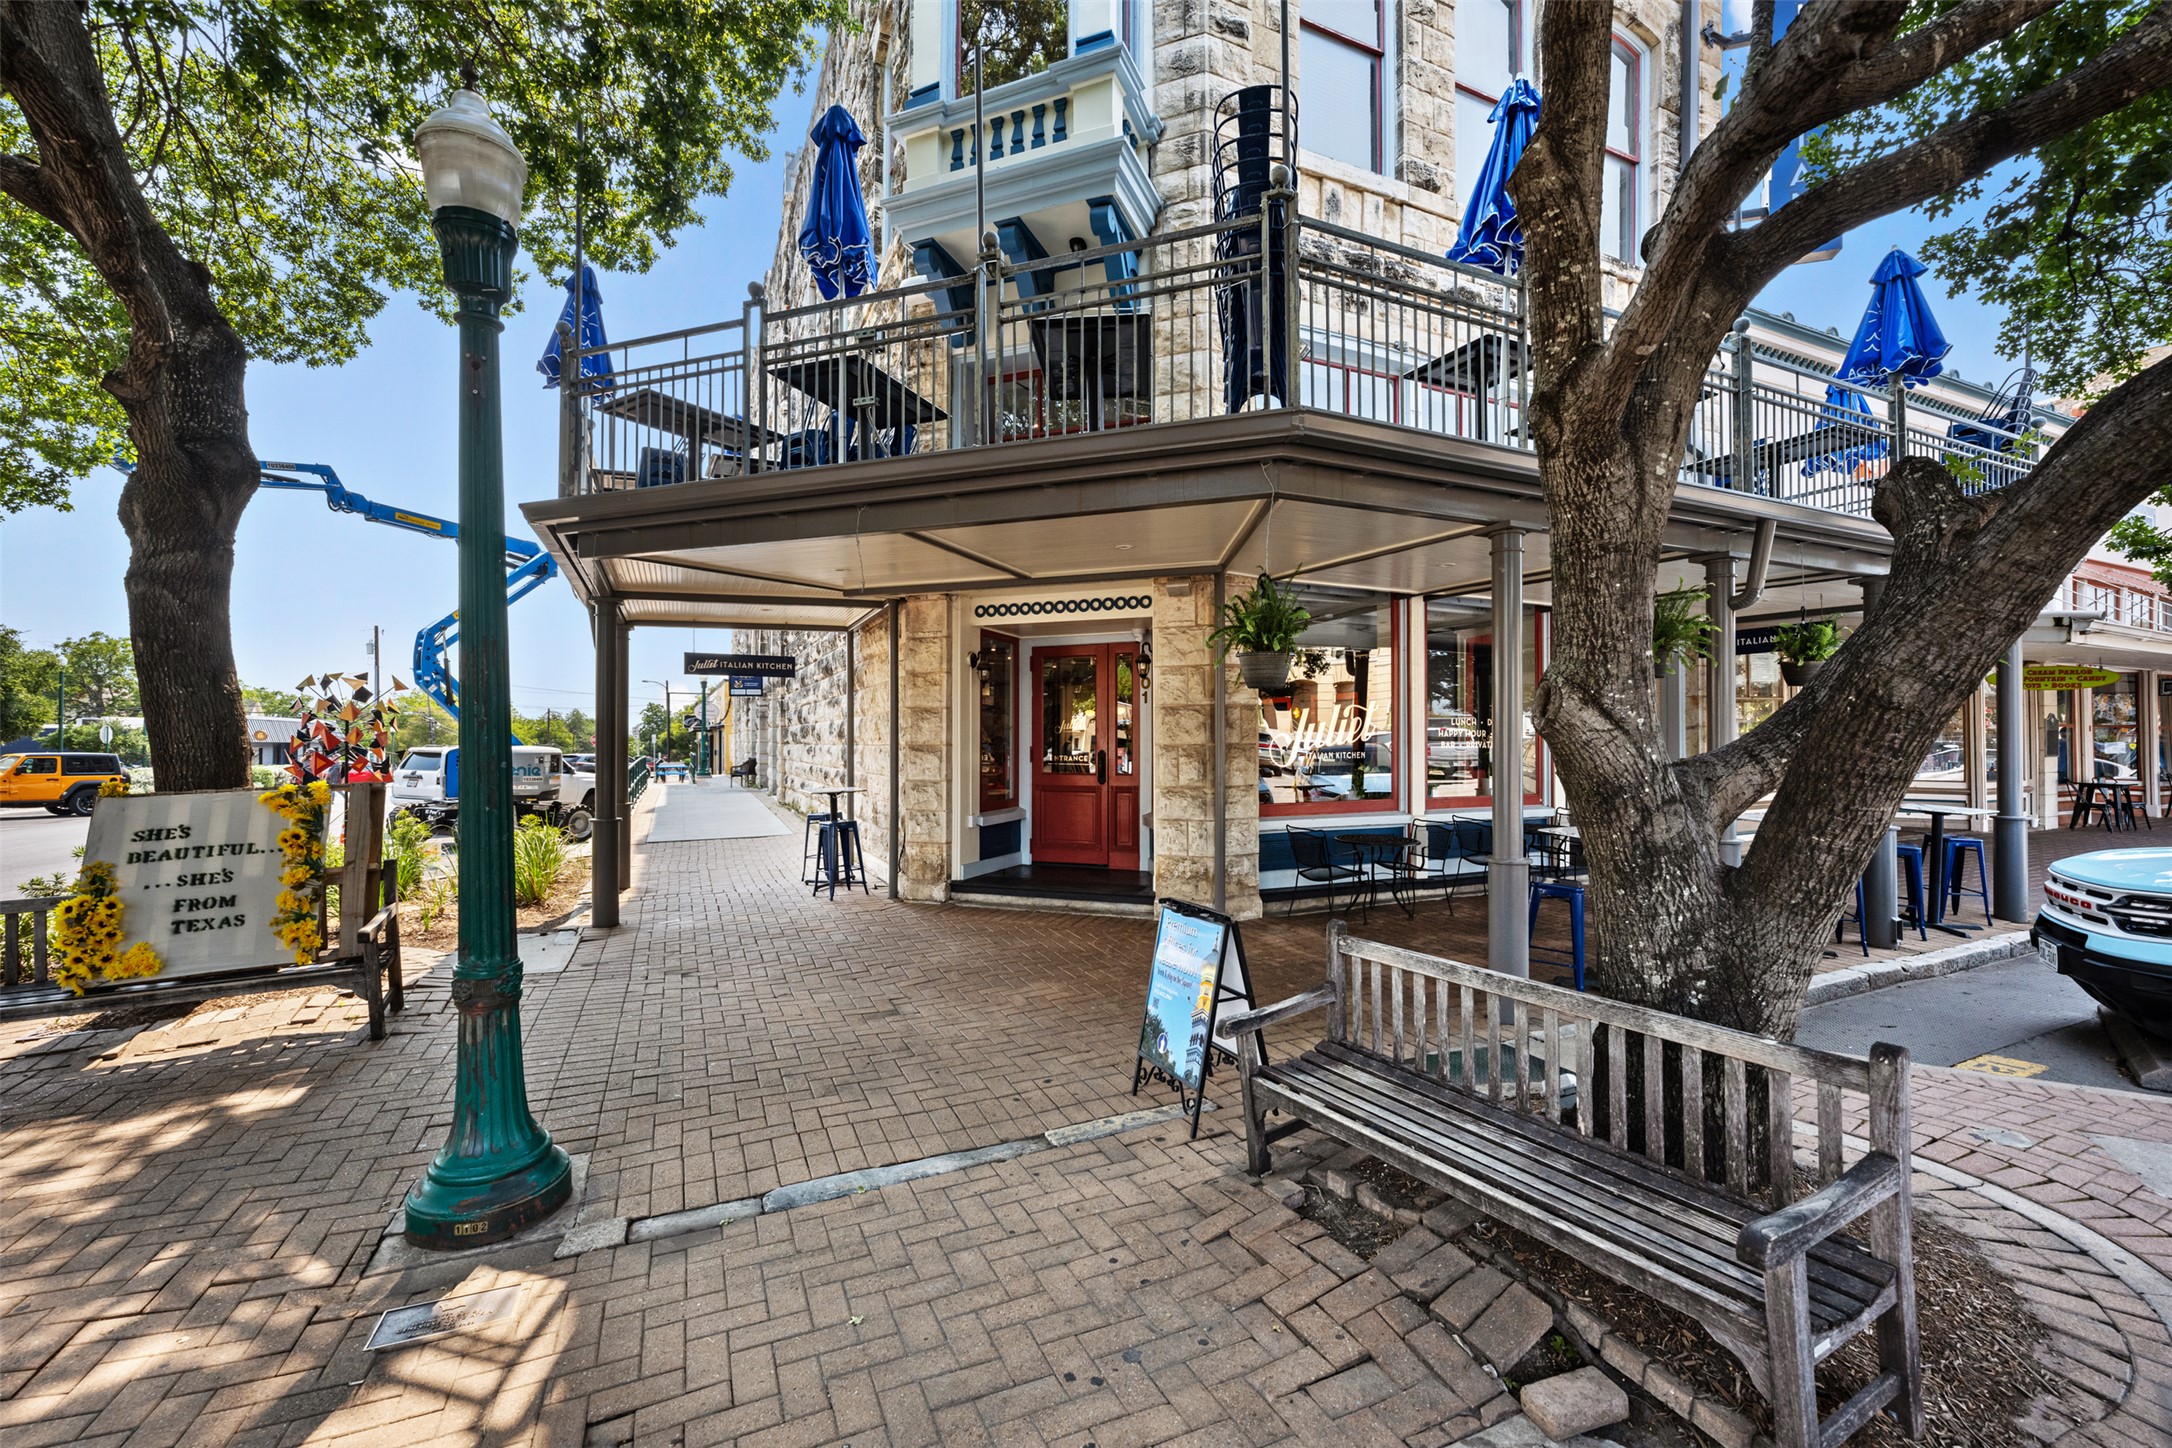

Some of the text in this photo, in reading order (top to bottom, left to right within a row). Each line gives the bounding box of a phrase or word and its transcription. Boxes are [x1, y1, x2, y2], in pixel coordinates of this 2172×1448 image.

[1736, 634, 1777, 646] ITALIAN
[688, 658, 793, 672] Juliet ITALIAN KITCHEN
[1451, 717, 1477, 726] LUNCH
[1269, 701, 1379, 768] Juliet
[1438, 729, 1486, 737] HAPPY HOUR
[1335, 751, 1366, 759] KITCHEN
[512, 763, 541, 776] enie
[130, 824, 192, 843] SHE'S
[172, 894, 238, 913] FROM
[171, 913, 246, 935] TEXAS
[1165, 916, 1198, 938] Premium
[455, 1222, 488, 1235] 1102
